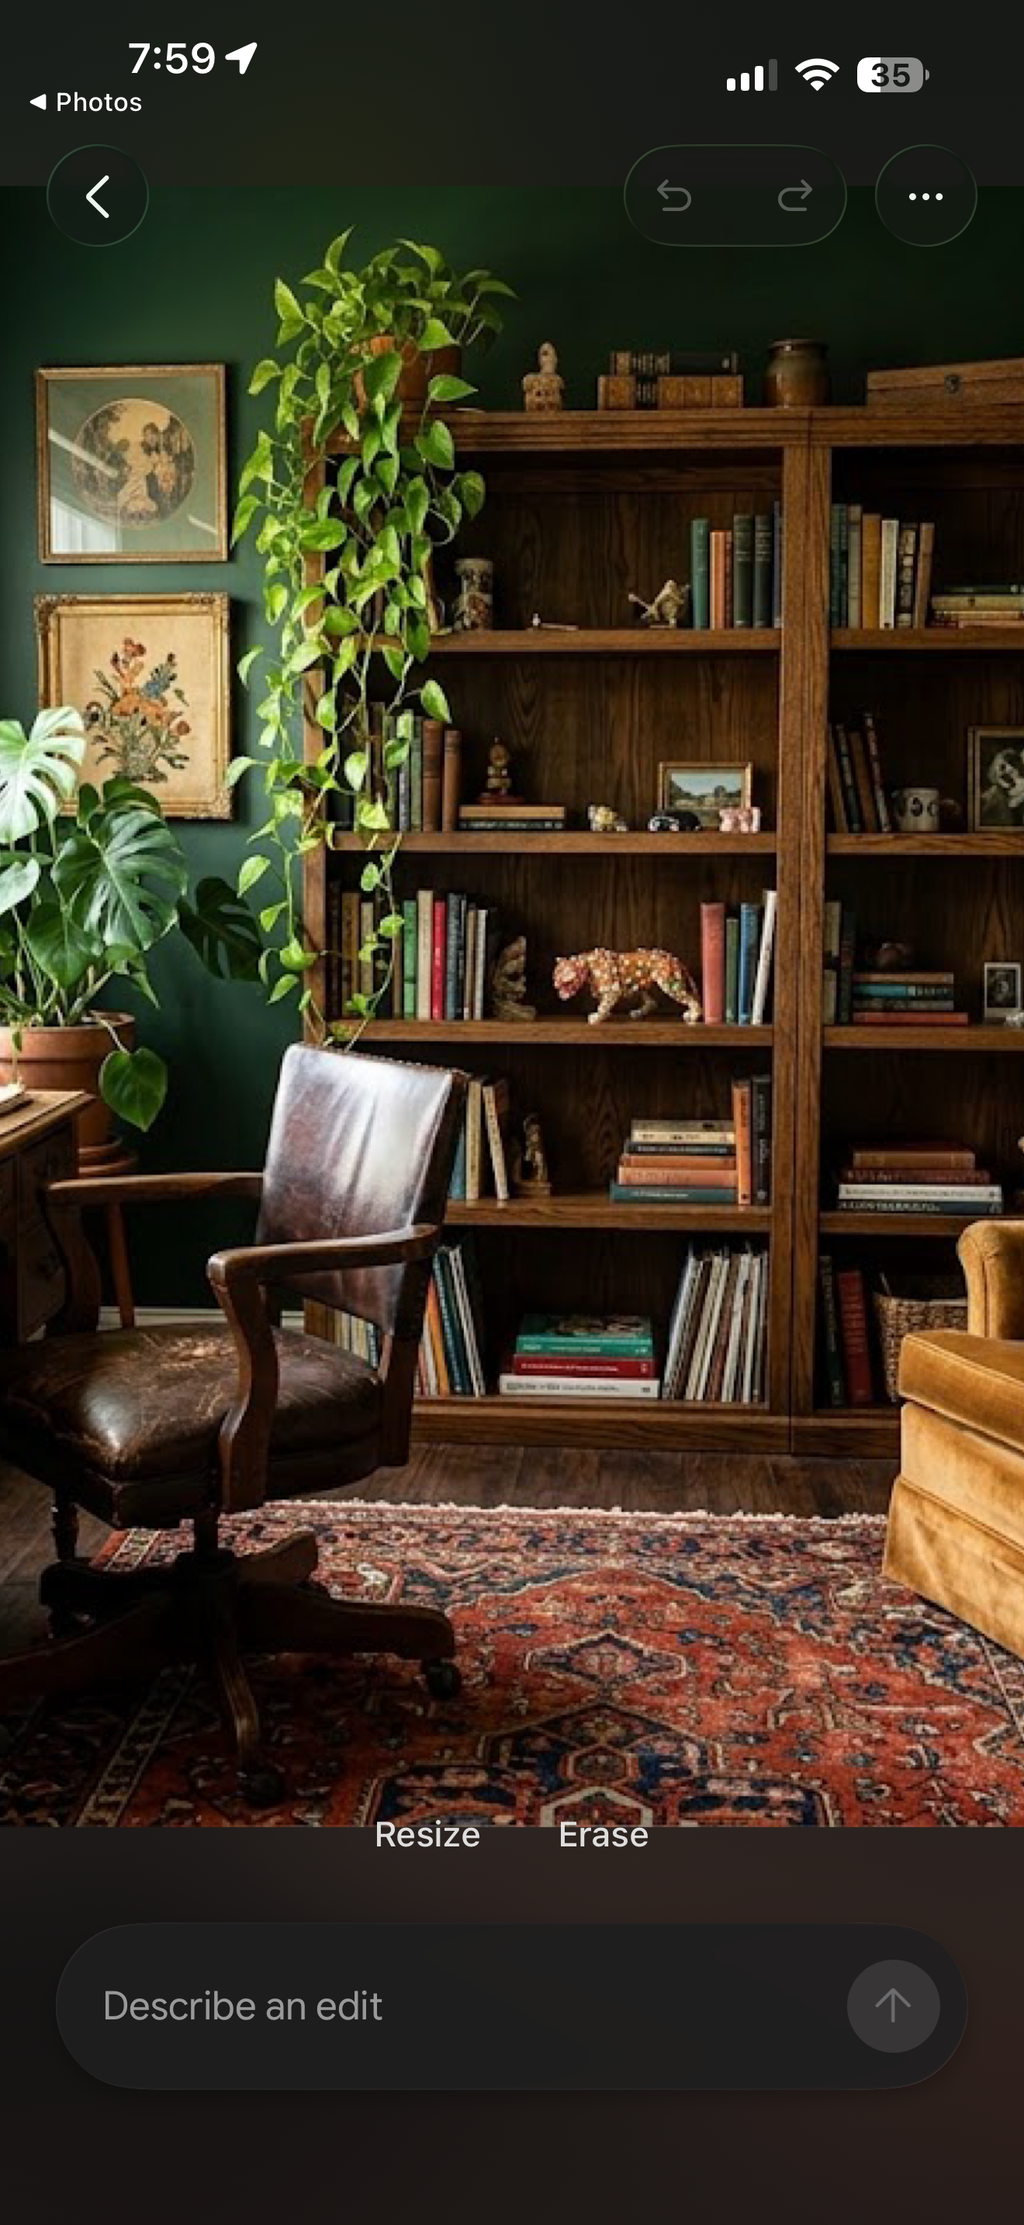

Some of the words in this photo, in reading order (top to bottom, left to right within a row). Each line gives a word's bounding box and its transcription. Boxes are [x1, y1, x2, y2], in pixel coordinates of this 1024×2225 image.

[128, 42, 216, 75] 7:59
[871, 62, 911, 88] 35
[56, 91, 142, 112] Photos
[375, 1820, 480, 1848] Resize
[559, 1821, 649, 1848] Erase
[104, 1989, 256, 2021] Describe
[266, 1997, 306, 2021] an
[316, 1989, 383, 2021] edit
